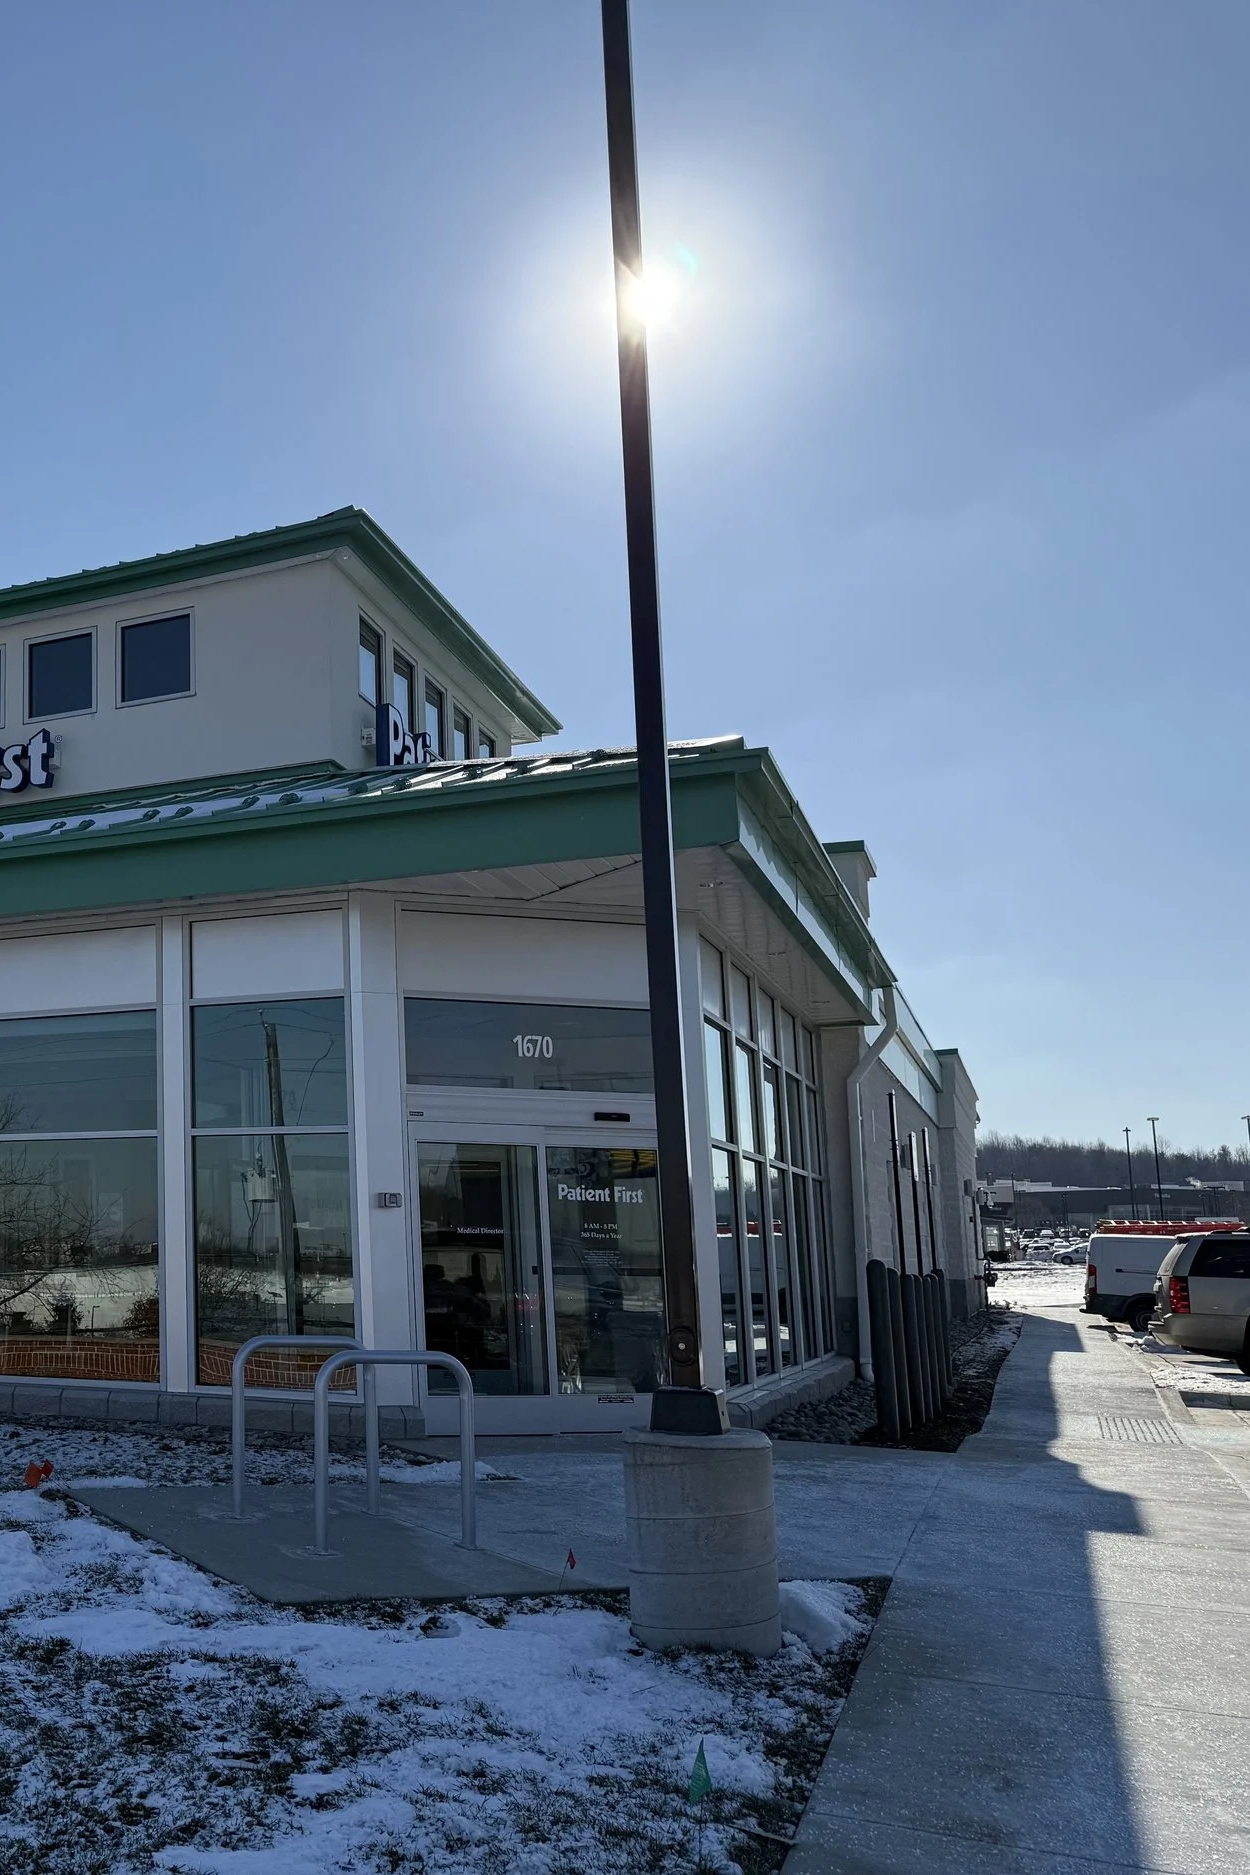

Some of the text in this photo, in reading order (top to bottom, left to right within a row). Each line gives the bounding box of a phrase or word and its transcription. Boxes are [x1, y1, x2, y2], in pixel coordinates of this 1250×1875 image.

[512, 1034, 554, 1059] 1670
[557, 1183, 644, 1204] Patient First
[480, 1227, 505, 1235] Director
[591, 1232, 605, 1240] Days
